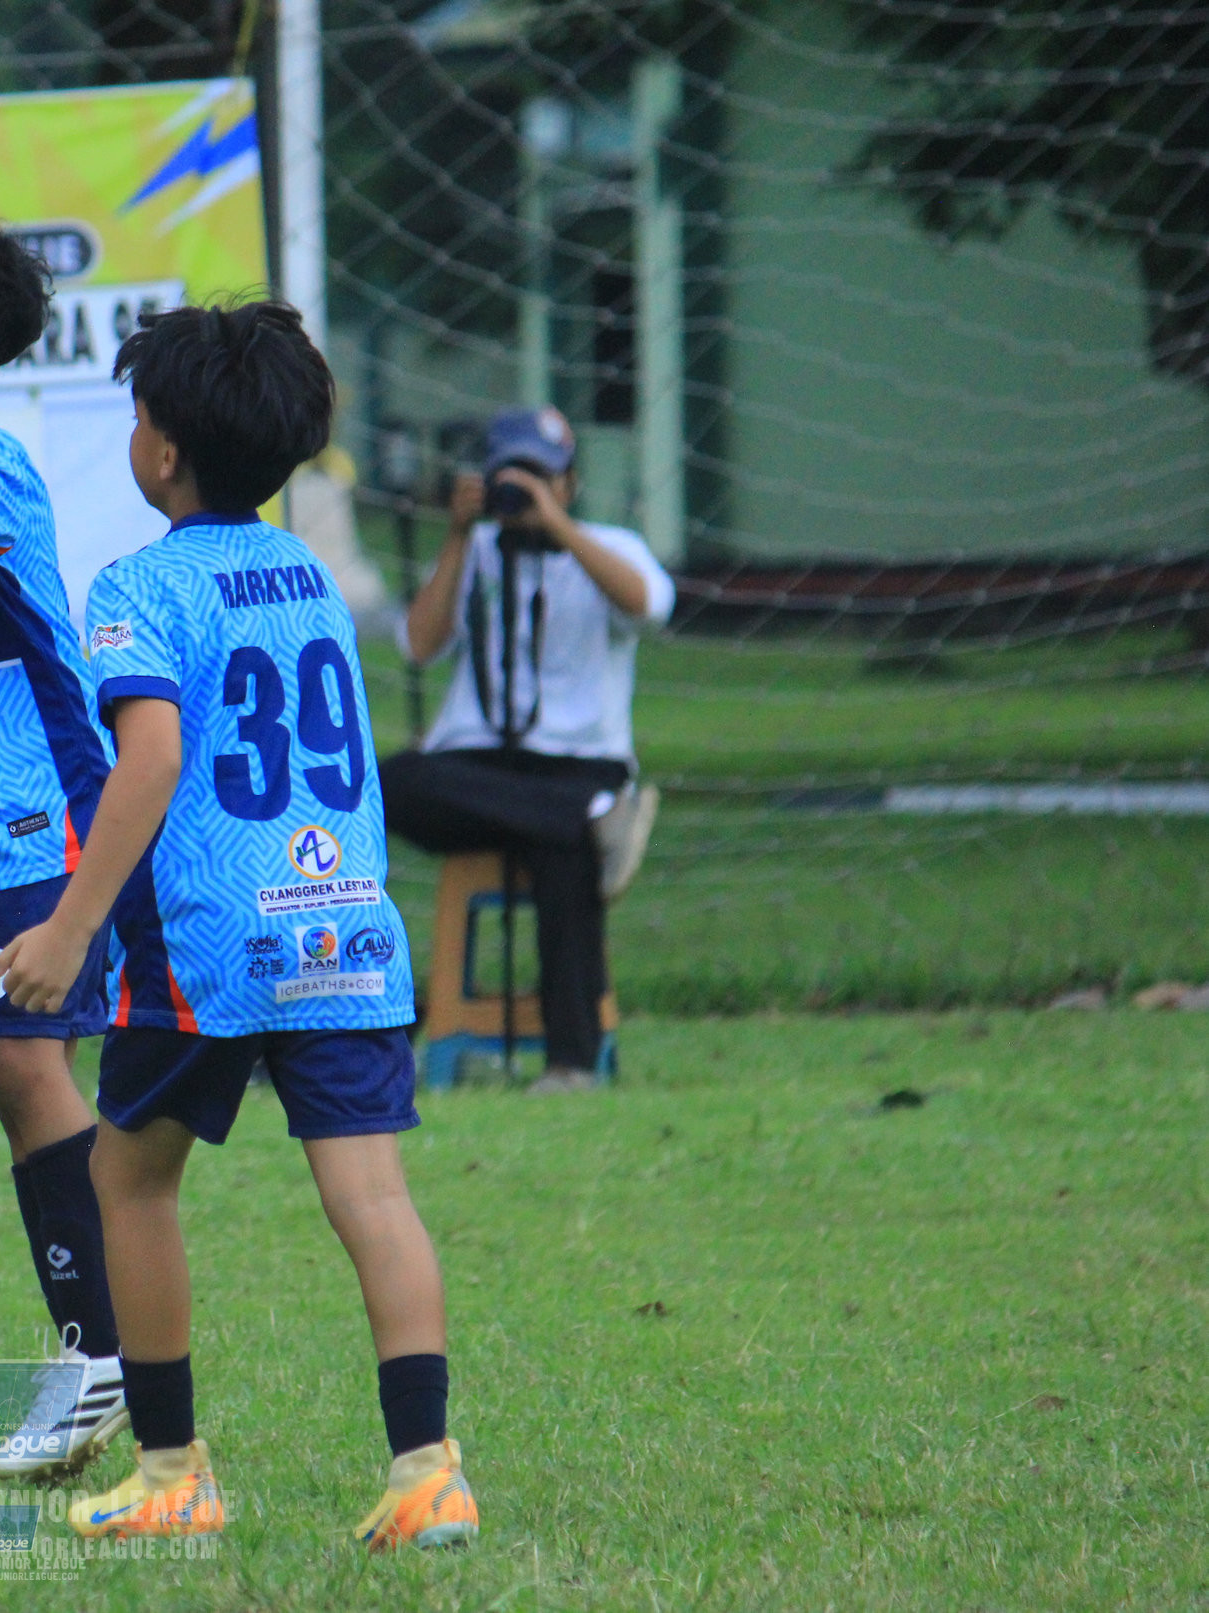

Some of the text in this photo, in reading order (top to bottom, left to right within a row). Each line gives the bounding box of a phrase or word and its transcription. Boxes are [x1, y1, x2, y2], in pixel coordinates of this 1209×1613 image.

[213, 637, 366, 822] 39
[260, 879, 378, 902] CV.ANGGREK LESTARI
[302, 959, 338, 971] RAN
